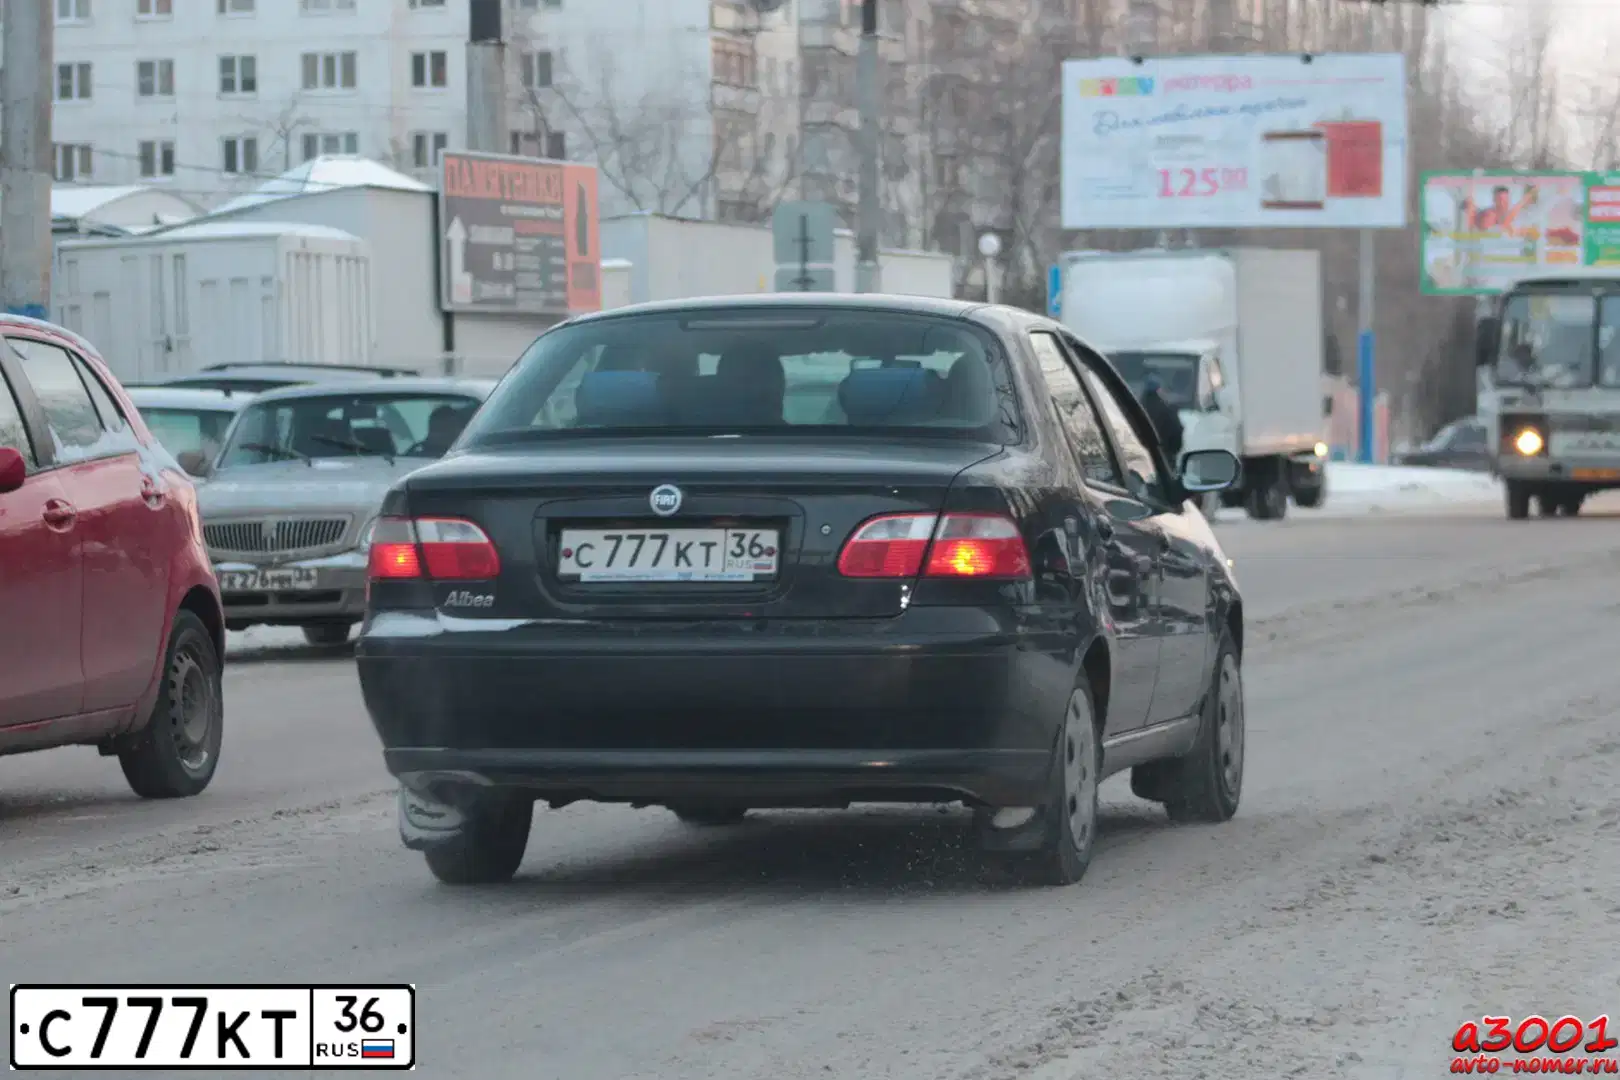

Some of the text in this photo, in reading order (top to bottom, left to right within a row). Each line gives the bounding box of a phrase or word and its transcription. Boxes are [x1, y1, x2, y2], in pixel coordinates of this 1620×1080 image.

[1157, 168, 1219, 197] 125
[654, 495, 677, 506] FIAT
[730, 533, 765, 558] 36
[727, 559, 752, 569] RUS
[444, 590, 495, 607] Albea
